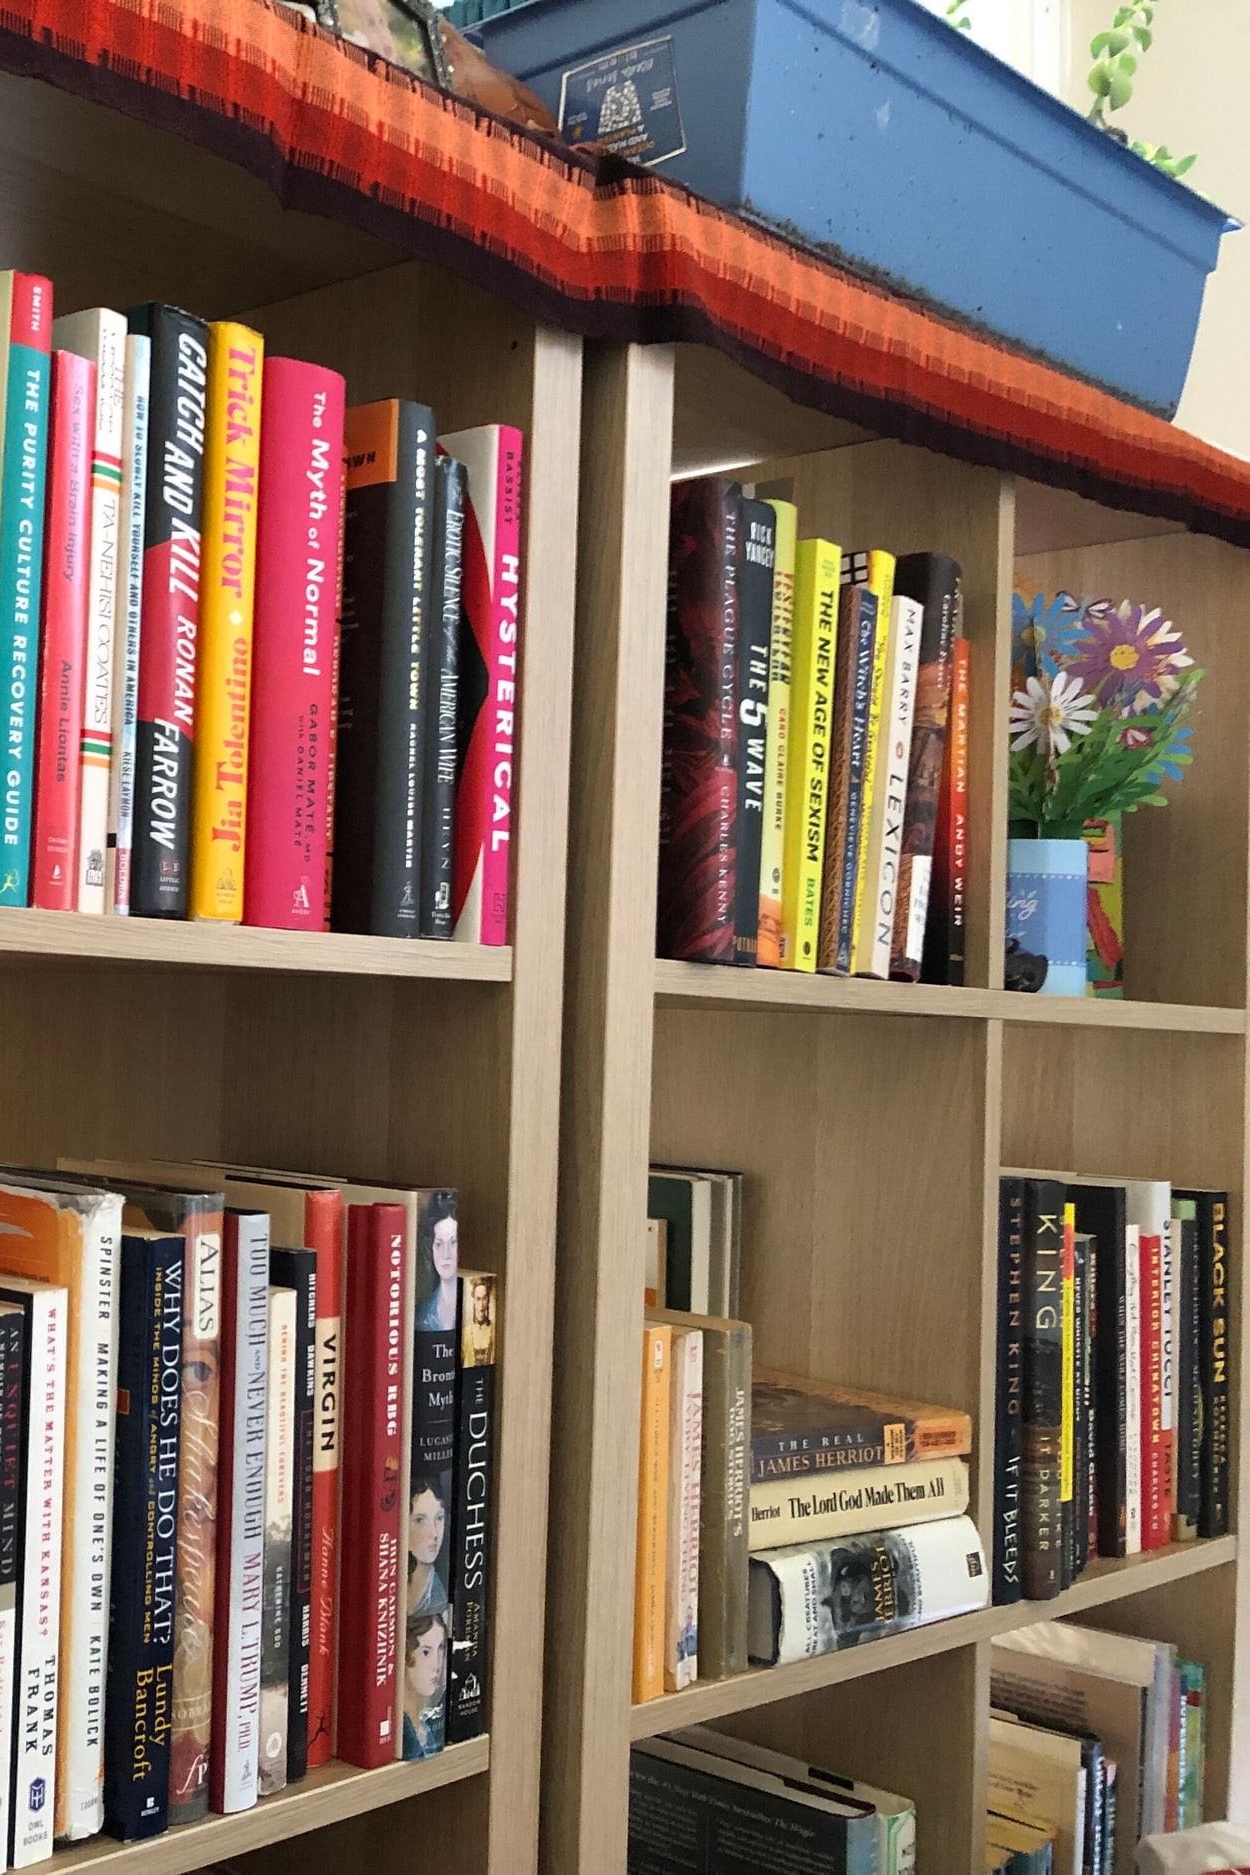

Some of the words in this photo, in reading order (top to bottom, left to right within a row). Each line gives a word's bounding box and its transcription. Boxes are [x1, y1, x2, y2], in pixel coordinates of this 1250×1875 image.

[31, 286, 42, 332] SMITH
[25, 370, 41, 413] THE
[175, 333, 207, 454] CATCH
[226, 347, 256, 445] Trick
[311, 392, 326, 428] The
[20, 423, 38, 509] PURITY
[163, 441, 196, 515] AND
[307, 439, 330, 519] Myth
[504, 452, 513, 524] BASSIST
[97, 499, 117, 620] TA-NEHISI
[169, 517, 201, 602] KILL
[221, 458, 254, 598] Mirror
[308, 527, 320, 550] of
[751, 521, 773, 544] RICK
[15, 519, 33, 624] CULTURE
[819, 590, 833, 622] THE
[302, 559, 326, 675] Normal
[902, 608, 917, 651] MAX
[8, 635, 27, 760] RECOVERY
[60, 661, 72, 711] Annie
[94, 622, 112, 725] COATES
[173, 615, 196, 725] RONAN
[749, 644, 768, 692] THE
[816, 641, 833, 686] NEW
[897, 661, 910, 724] BARRY
[958, 659, 967, 693] THE
[215, 637, 248, 791] Tolentino
[491, 555, 518, 852] HYSTERICAL
[739, 700, 766, 727] 5
[813, 693, 828, 736] AGE
[56, 716, 70, 783] Liontas
[122, 751, 132, 778] KIESE
[149, 718, 179, 849] FARROW
[745, 737, 765, 811] WAVE
[812, 741, 824, 773] OF
[956, 704, 966, 792] MARTIAN
[4, 770, 22, 845] GUIDE
[120, 781, 131, 817] LAYMON
[212, 800, 242, 852] Jia
[719, 786, 729, 861] CHARLES
[806, 778, 822, 863] SEXISM
[877, 774, 905, 946] LEXICON
[955, 814, 964, 868] ANDY
[717, 869, 728, 923] KENNY
[805, 878, 815, 927] BATES
[954, 877, 963, 926] WEIR
[199, 1241, 219, 1332] ALIAS
[1009, 1197, 1020, 1327] STEPHEN
[1036, 1214, 1057, 1329] KING
[1213, 1203, 1224, 1306] BLACK
[164, 1261, 181, 1333] WHY
[387, 1235, 401, 1375] NOTORIOUS
[160, 1342, 179, 1427] DOES
[433, 1344, 453, 1358] The
[1008, 1343, 1020, 1415] KING
[1213, 1318, 1225, 1383] SUN
[320, 1334, 335, 1451] VIRGIN
[386, 1385, 398, 1436] RBG
[429, 1391, 453, 1410] Myth
[159, 1438, 177, 1481] HE
[758, 1456, 810, 1477] JAMES
[815, 1449, 882, 1467] HERRIOT
[778, 1439, 809, 1450] THE
[821, 1433, 864, 1447] REAL
[157, 1490, 174, 1540] DO
[751, 1506, 780, 1521] Herriot
[789, 1497, 810, 1518] The
[813, 1493, 837, 1516] Lord
[840, 1490, 862, 1511] God
[865, 1486, 894, 1508] Made
[895, 1482, 925, 1502] Them
[927, 1478, 944, 1498] All
[320, 1526, 335, 1587] Hanne
[379, 1533, 389, 1592] SHANA
[152, 1553, 174, 1644] THAT?
[319, 1596, 334, 1655] Blank
[376, 1599, 388, 1687] KNIZHNIK
[26, 1668, 40, 1753] FRANK
[41, 1655, 55, 1756] THOMAS
[133, 1668, 154, 1781] Bancroft
[149, 1663, 172, 1746] Lundy
[23, 1832, 48, 1846] BOOKS
[28, 1820, 43, 1831] OWL
